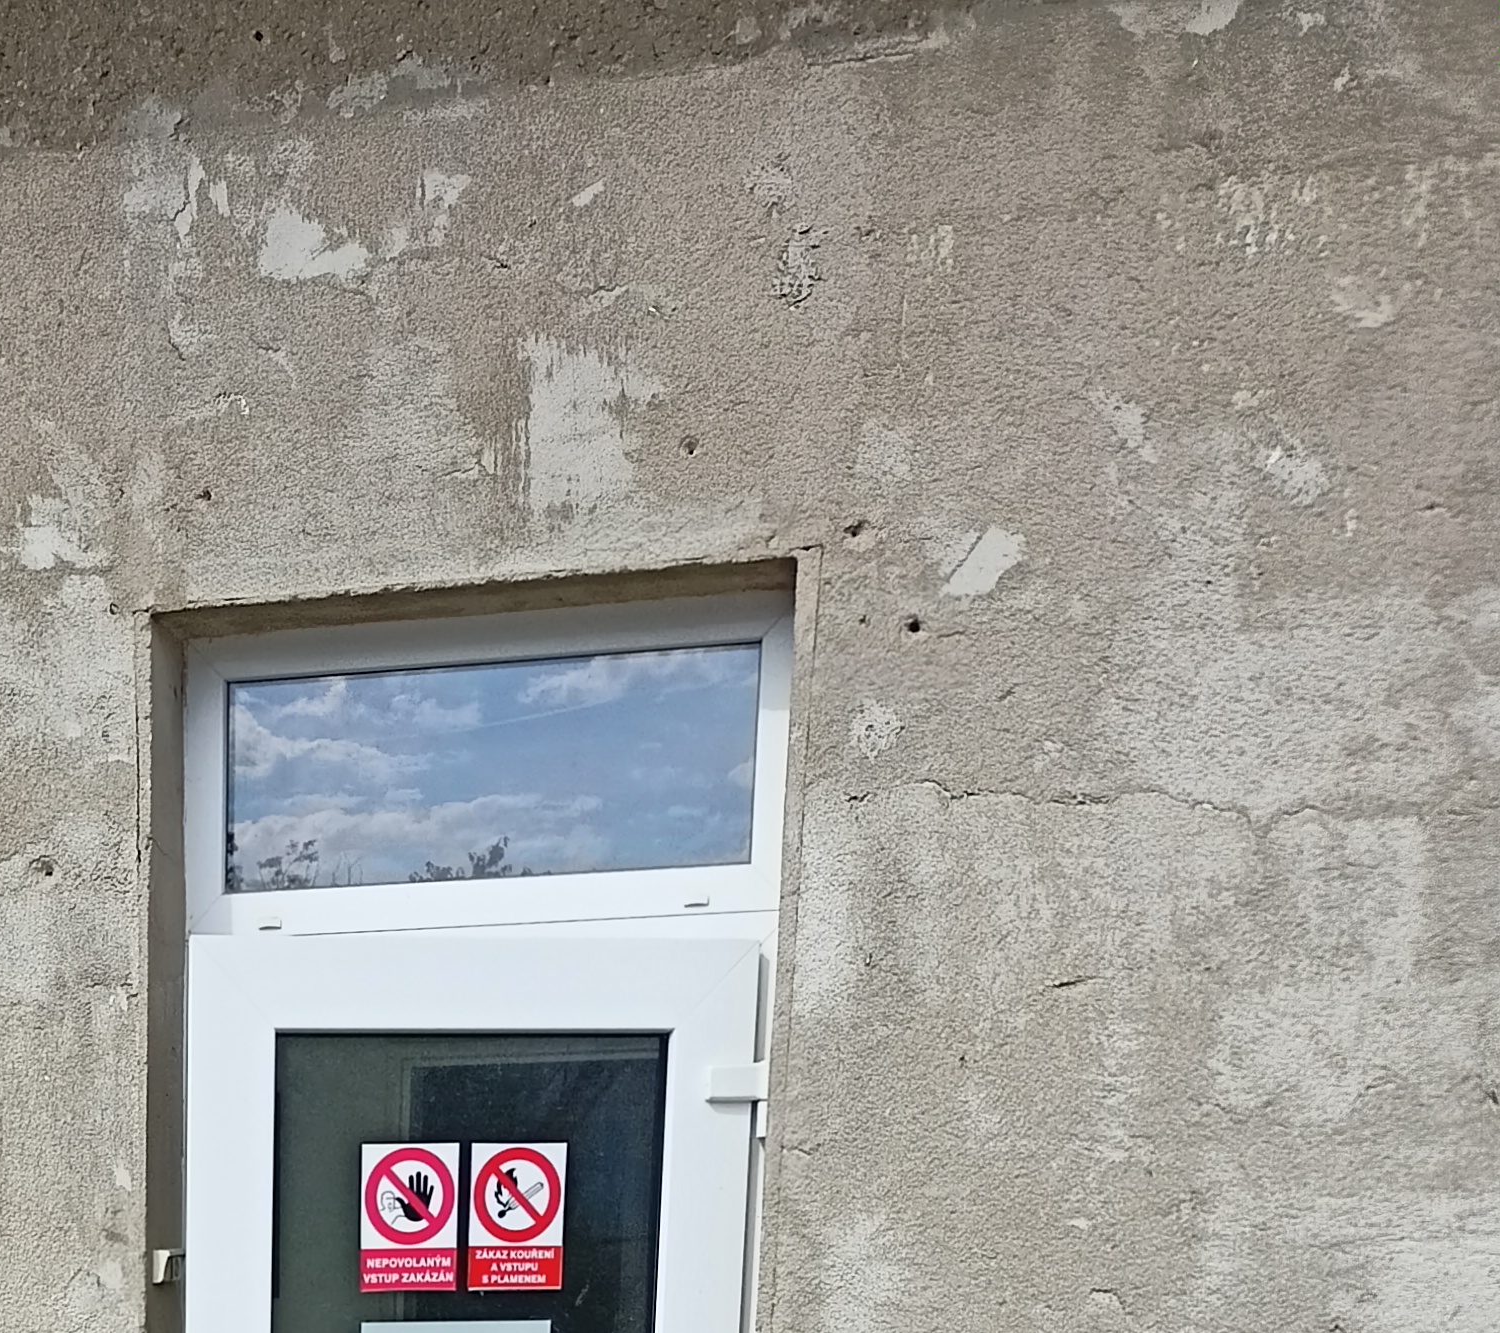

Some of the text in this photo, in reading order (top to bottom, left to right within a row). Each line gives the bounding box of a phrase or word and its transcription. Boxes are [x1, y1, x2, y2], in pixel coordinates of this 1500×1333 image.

[475, 1247, 555, 1260] ZÁKAZ KOUŘENÍ
[366, 1255, 451, 1269] NEPOVOLANÝM
[490, 1262, 539, 1272] A VSTUPU
[363, 1270, 454, 1284] VSTUP ZAKÁZÁN
[481, 1274, 547, 1284] S PLAMENEM
